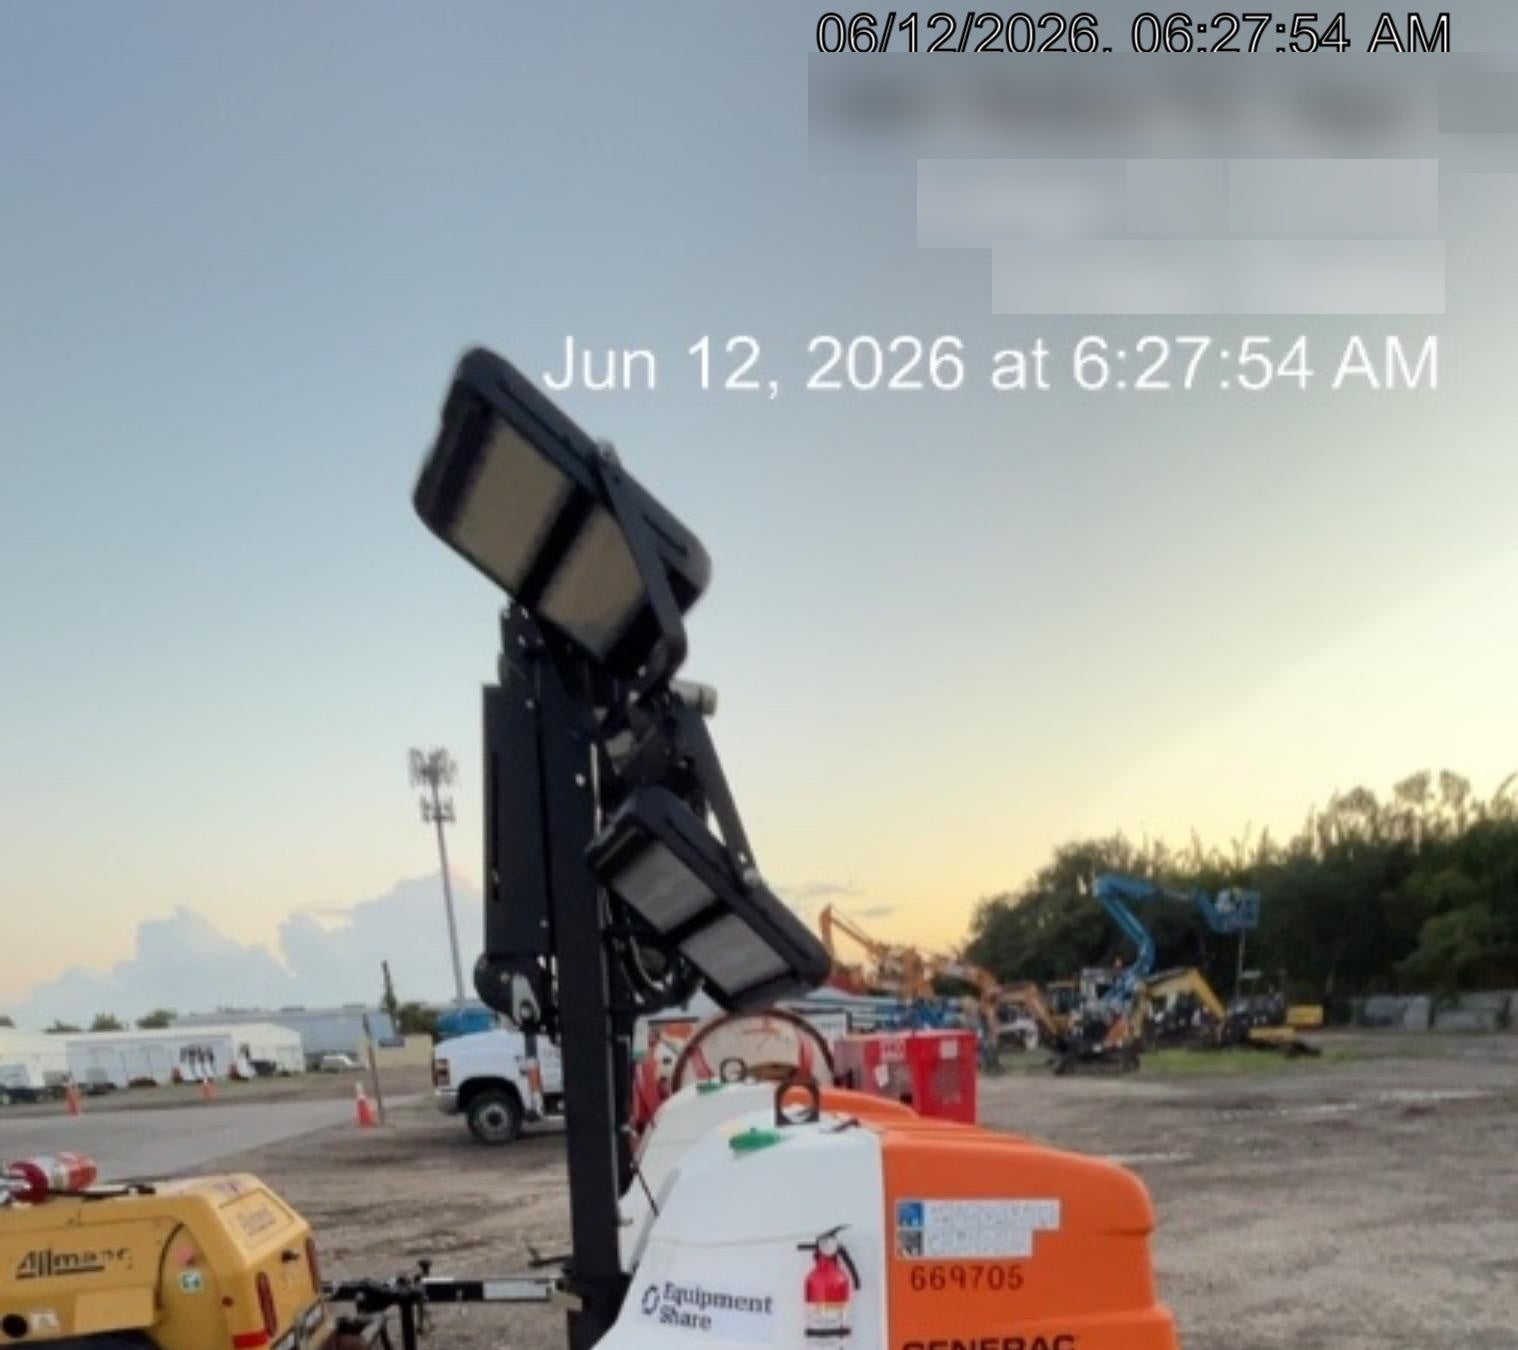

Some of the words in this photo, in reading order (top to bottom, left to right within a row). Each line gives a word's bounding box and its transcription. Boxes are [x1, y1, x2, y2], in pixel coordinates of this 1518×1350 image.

[910, 1264, 1024, 1291] 669705
[662, 1281, 772, 1314] Equipment
[659, 1304, 712, 1331] Share
